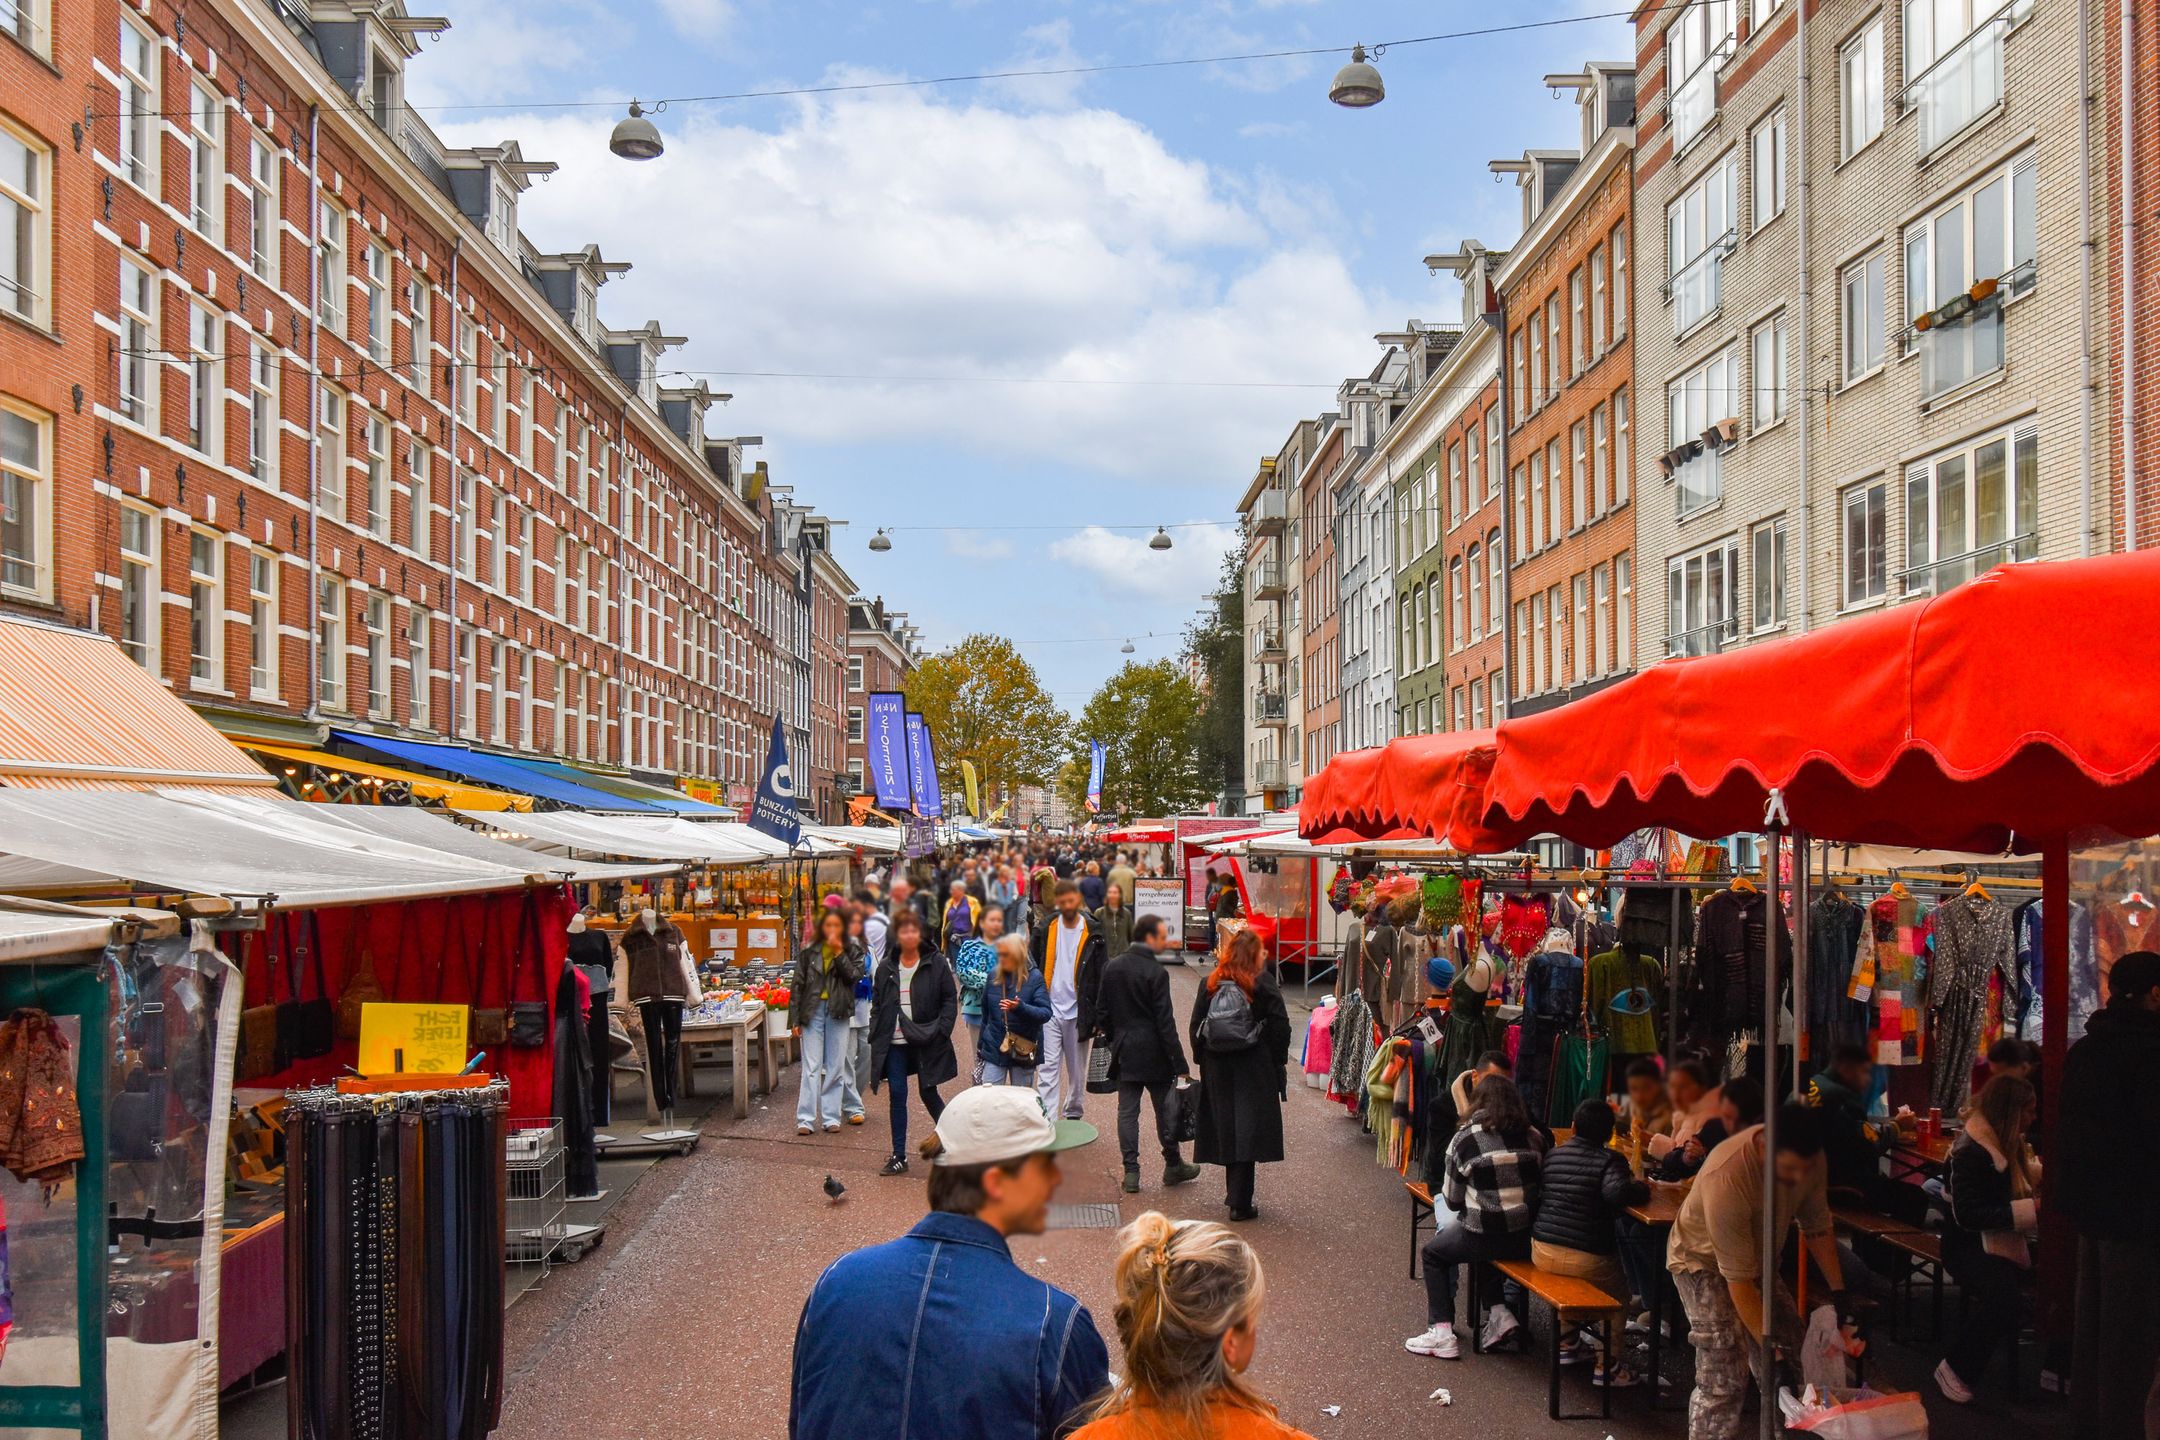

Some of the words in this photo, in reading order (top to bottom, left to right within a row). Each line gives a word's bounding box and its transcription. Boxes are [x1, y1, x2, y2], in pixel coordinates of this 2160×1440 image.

[756, 807, 796, 829] POTTERY
[759, 796, 798, 820] BUNZLAU
[1426, 1025, 1436, 1037] 10
